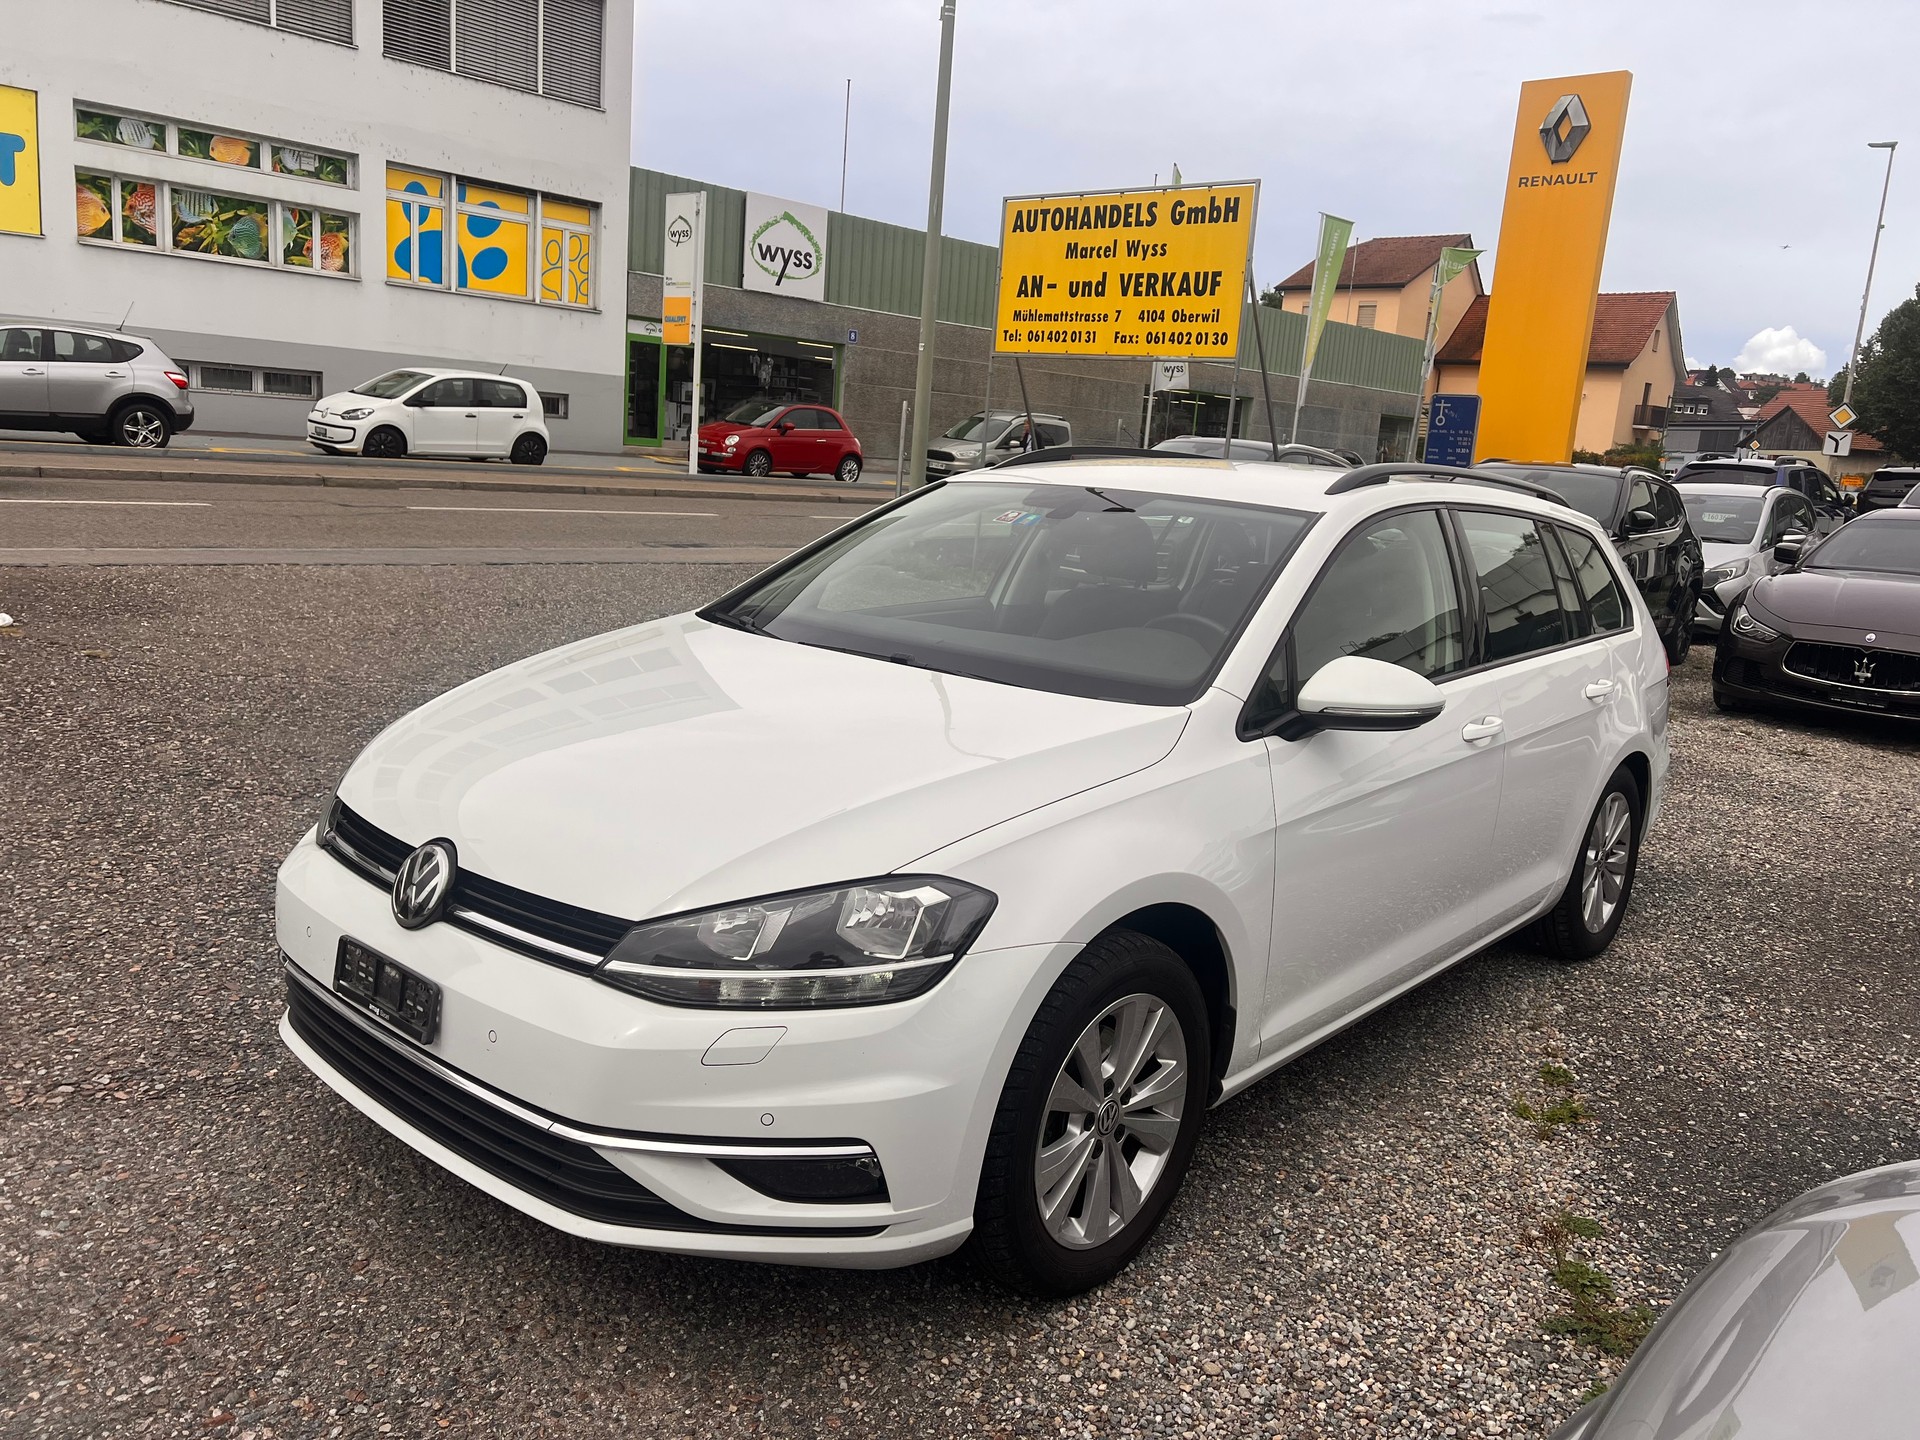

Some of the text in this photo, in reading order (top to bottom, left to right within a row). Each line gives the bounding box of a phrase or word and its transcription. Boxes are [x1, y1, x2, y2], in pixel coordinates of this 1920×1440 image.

[1518, 172, 1597, 187] RENAULT
[1012, 196, 1240, 233] AUTOHANDELS GmbH
[1065, 239, 1167, 261] Marcel Wyss
[757, 243, 812, 286] wyss
[1016, 271, 1222, 298] AN- und VERKAUF
[1013, 309, 1220, 322] Mühlemattstrasse 7 4104 Oberwil
[1003, 329, 1022, 342] Tel:
[1114, 331, 1139, 344] Fax:
